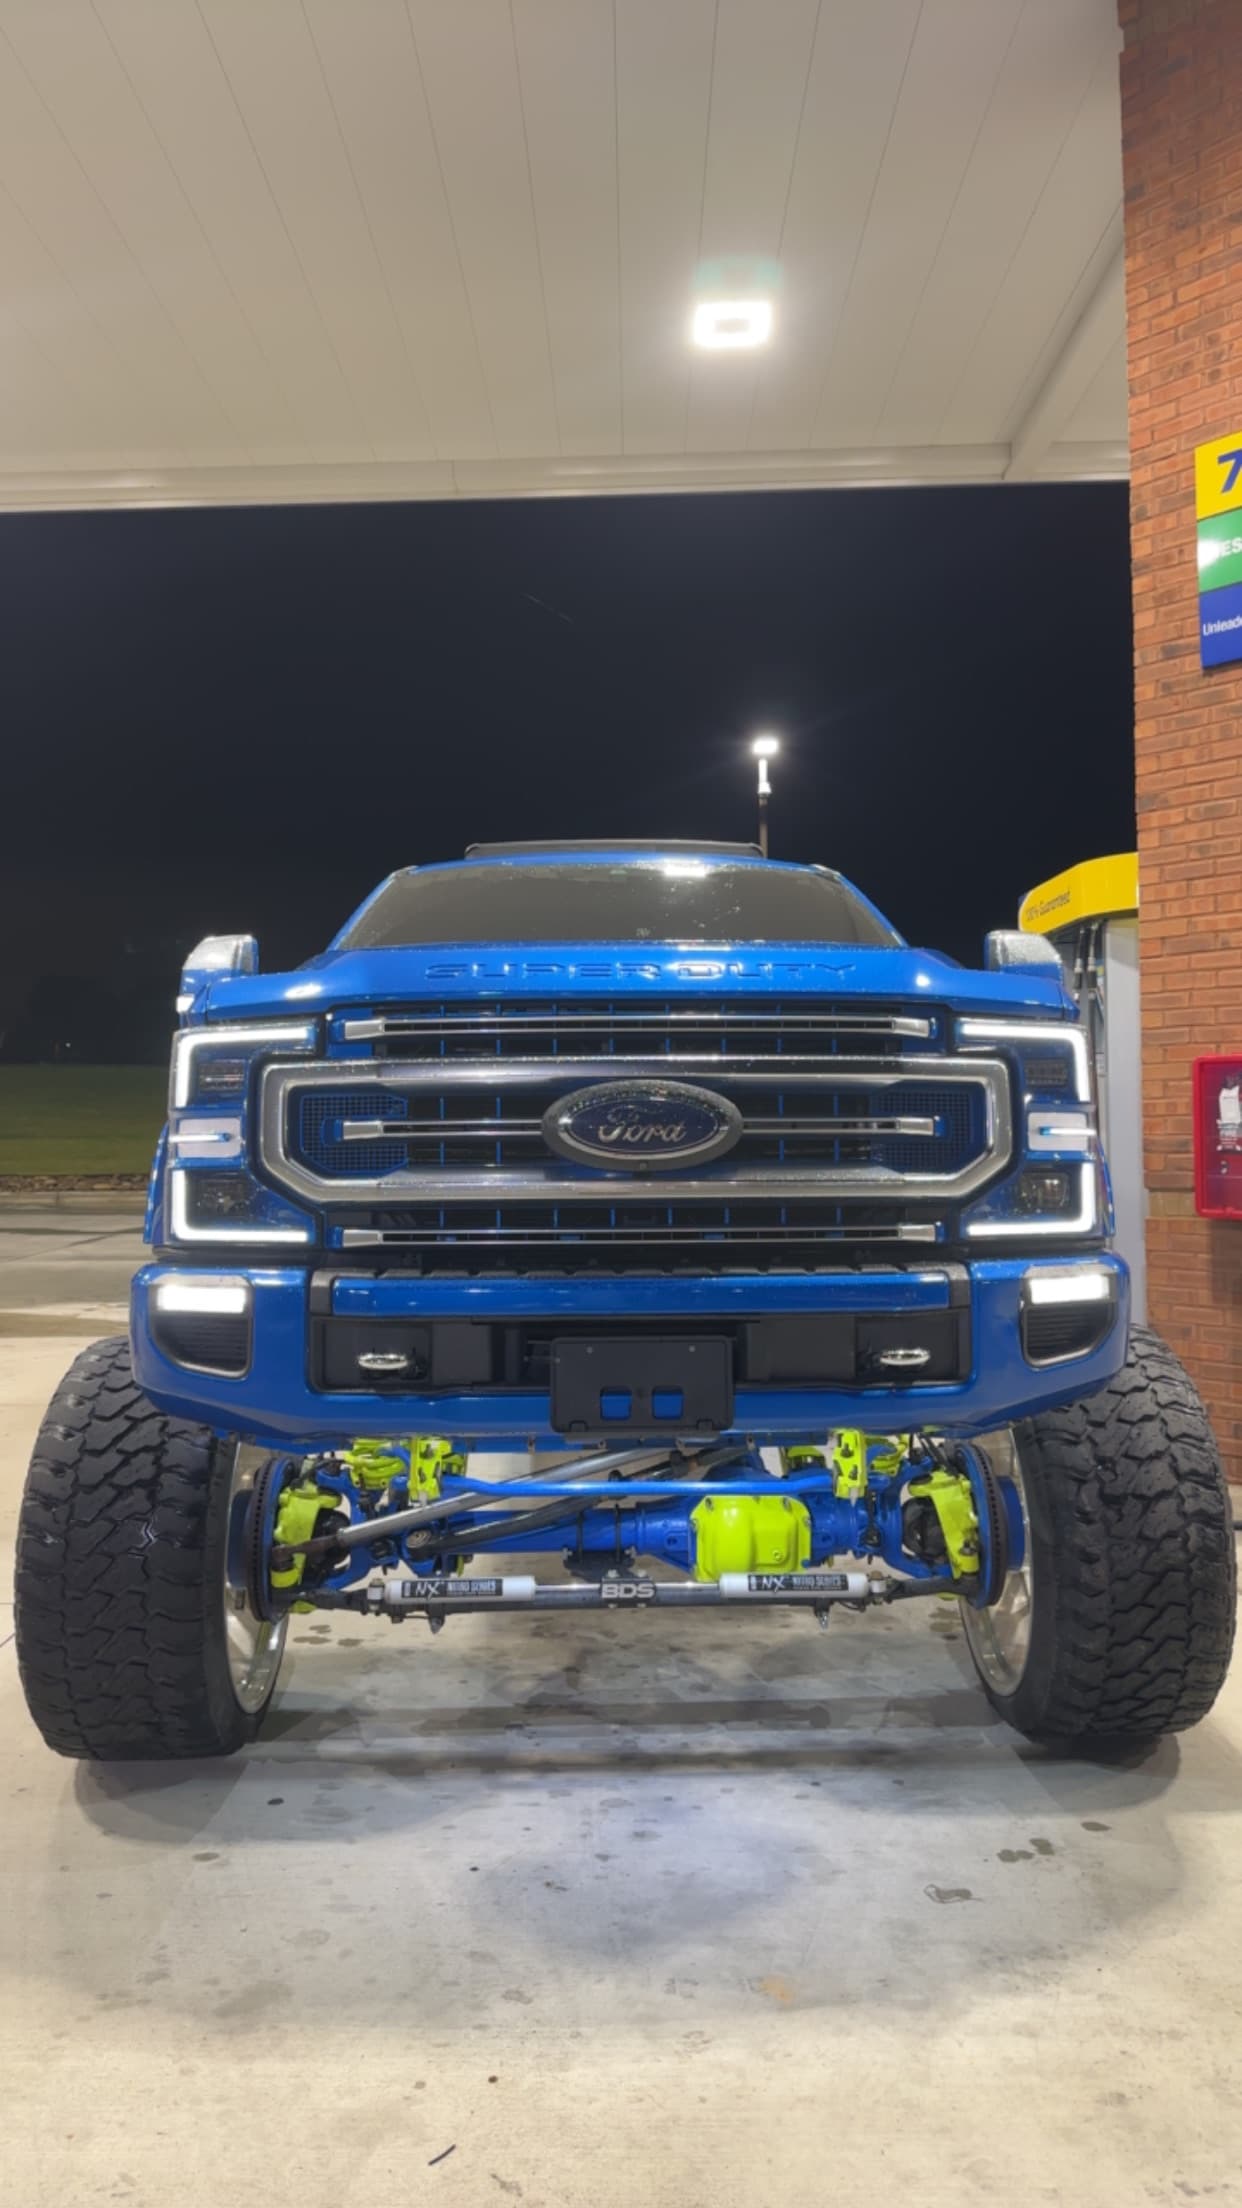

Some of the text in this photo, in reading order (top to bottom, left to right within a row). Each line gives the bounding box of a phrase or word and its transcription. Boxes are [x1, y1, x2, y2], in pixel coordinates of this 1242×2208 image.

[425, 962, 856, 980] SUPER DUTY
[598, 1106, 687, 1143] Ford
[601, 1583, 655, 1599] BDS
